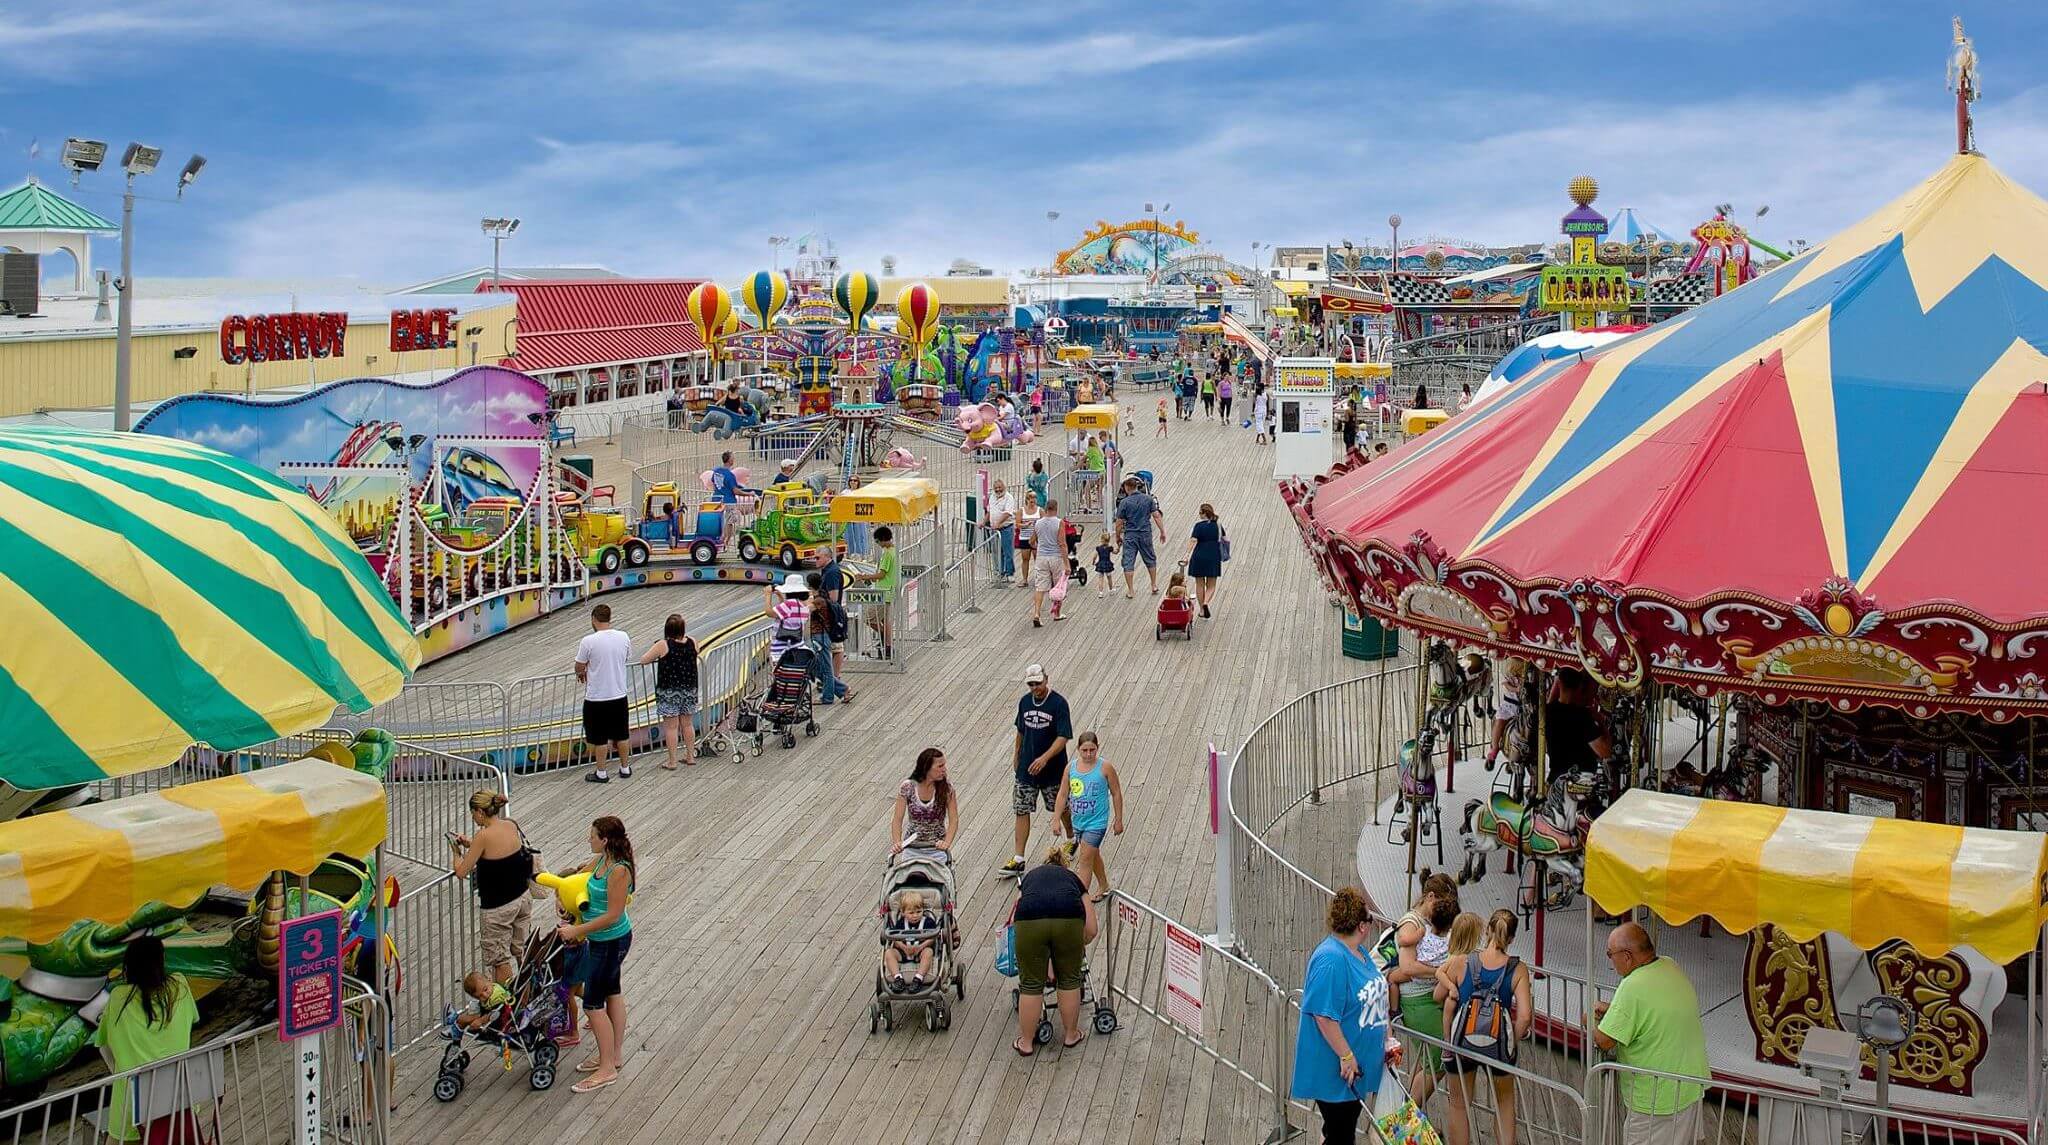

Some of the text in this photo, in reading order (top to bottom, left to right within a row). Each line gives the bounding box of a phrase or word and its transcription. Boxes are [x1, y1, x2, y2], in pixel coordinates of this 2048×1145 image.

[1078, 415, 1097, 424] ENTER
[854, 503, 874, 515] EXIT
[848, 592, 881, 602] EXIT
[1118, 901, 1139, 926] ENTER
[301, 928, 323, 960] 3
[288, 956, 337, 978] TICKETS
[297, 980, 327, 994] MUST BE
[305, 987, 330, 999] INCHES
[304, 1000, 328, 1013] UNDER
[299, 1008, 327, 1021] TO RIDE
[303, 1051, 314, 1063] 30
[307, 1109, 317, 1145] MINI
